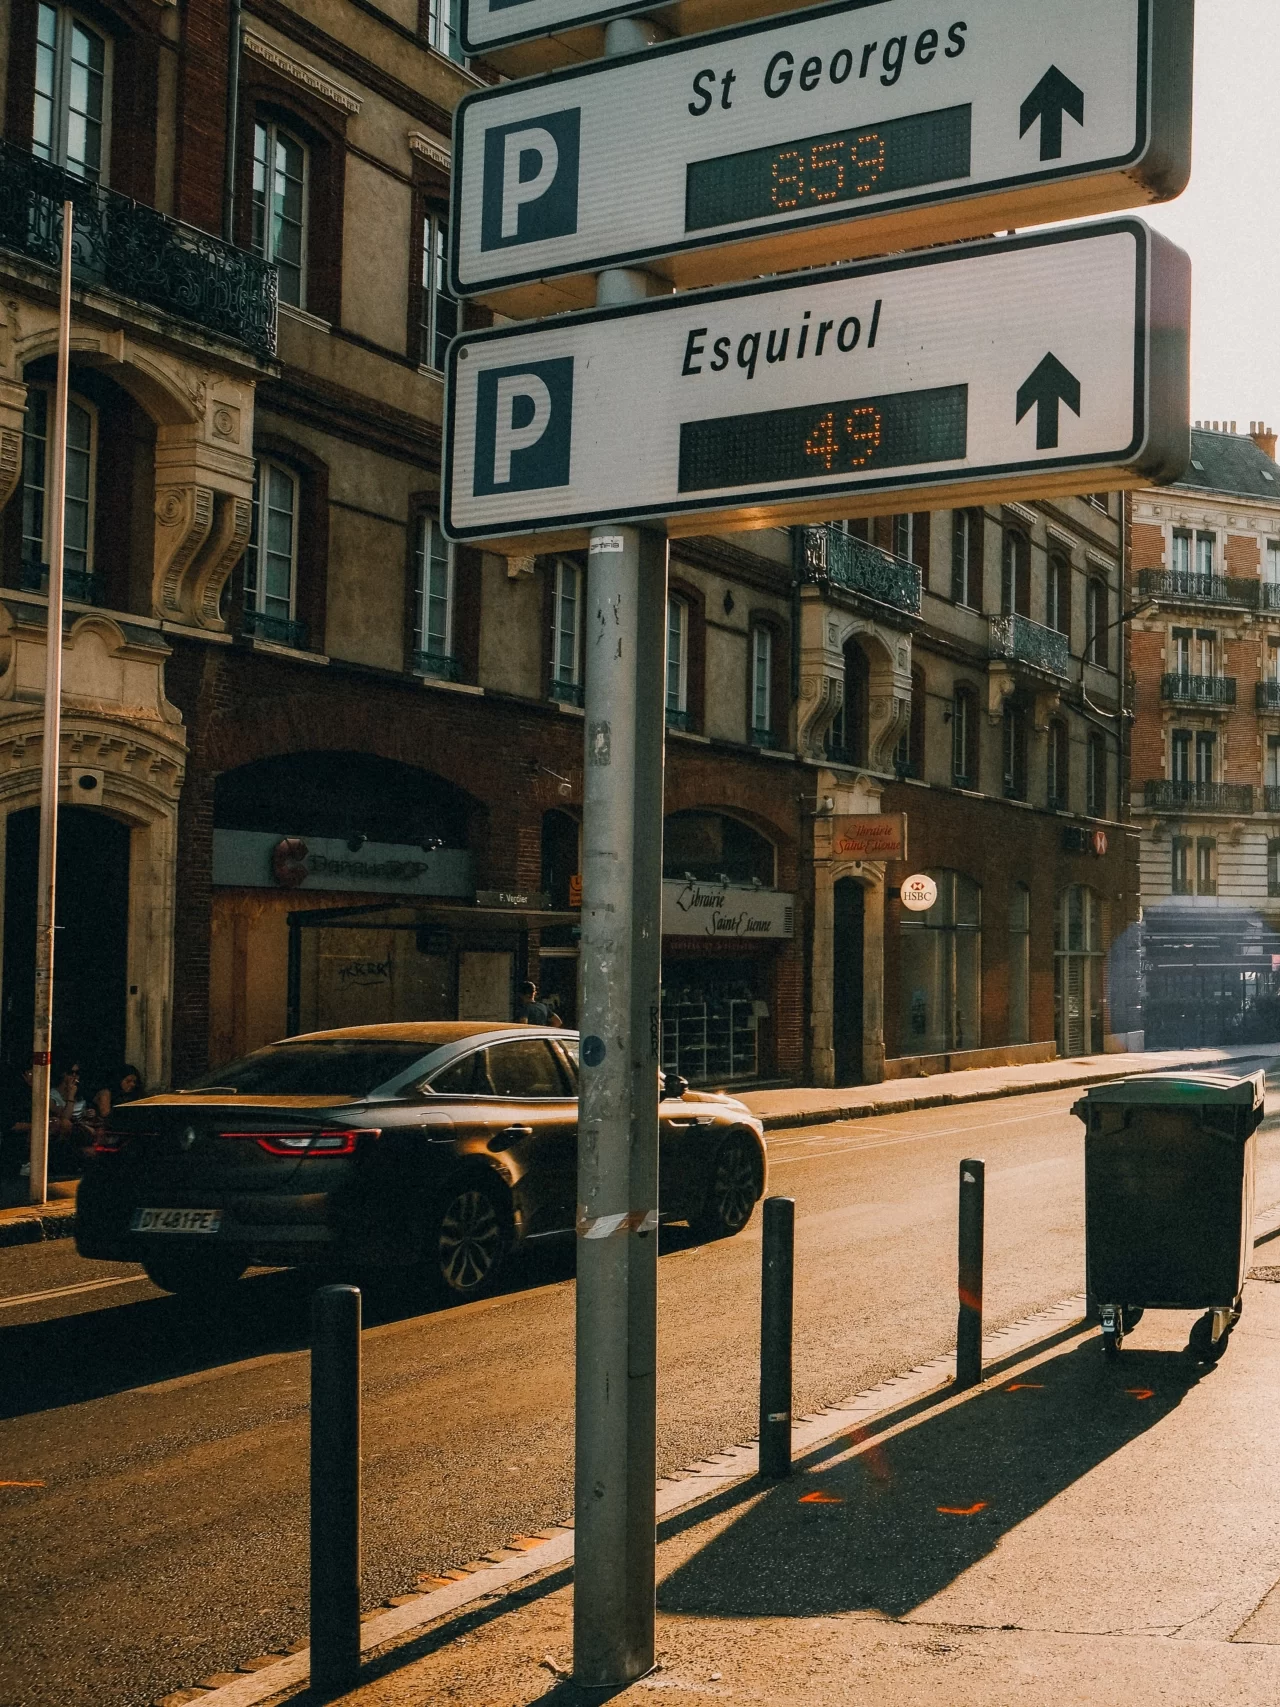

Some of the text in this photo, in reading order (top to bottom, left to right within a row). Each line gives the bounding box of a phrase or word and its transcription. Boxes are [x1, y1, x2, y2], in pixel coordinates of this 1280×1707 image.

[688, 21, 968, 117] St Georges
[501, 126, 559, 239] P
[771, 133, 886, 208] 859
[681, 299, 883, 379] Esquirol
[494, 373, 552, 485] P
[805, 406, 883, 470] 49
[677, 886, 725, 911] Librairie
[904, 892, 931, 901] HSBC
